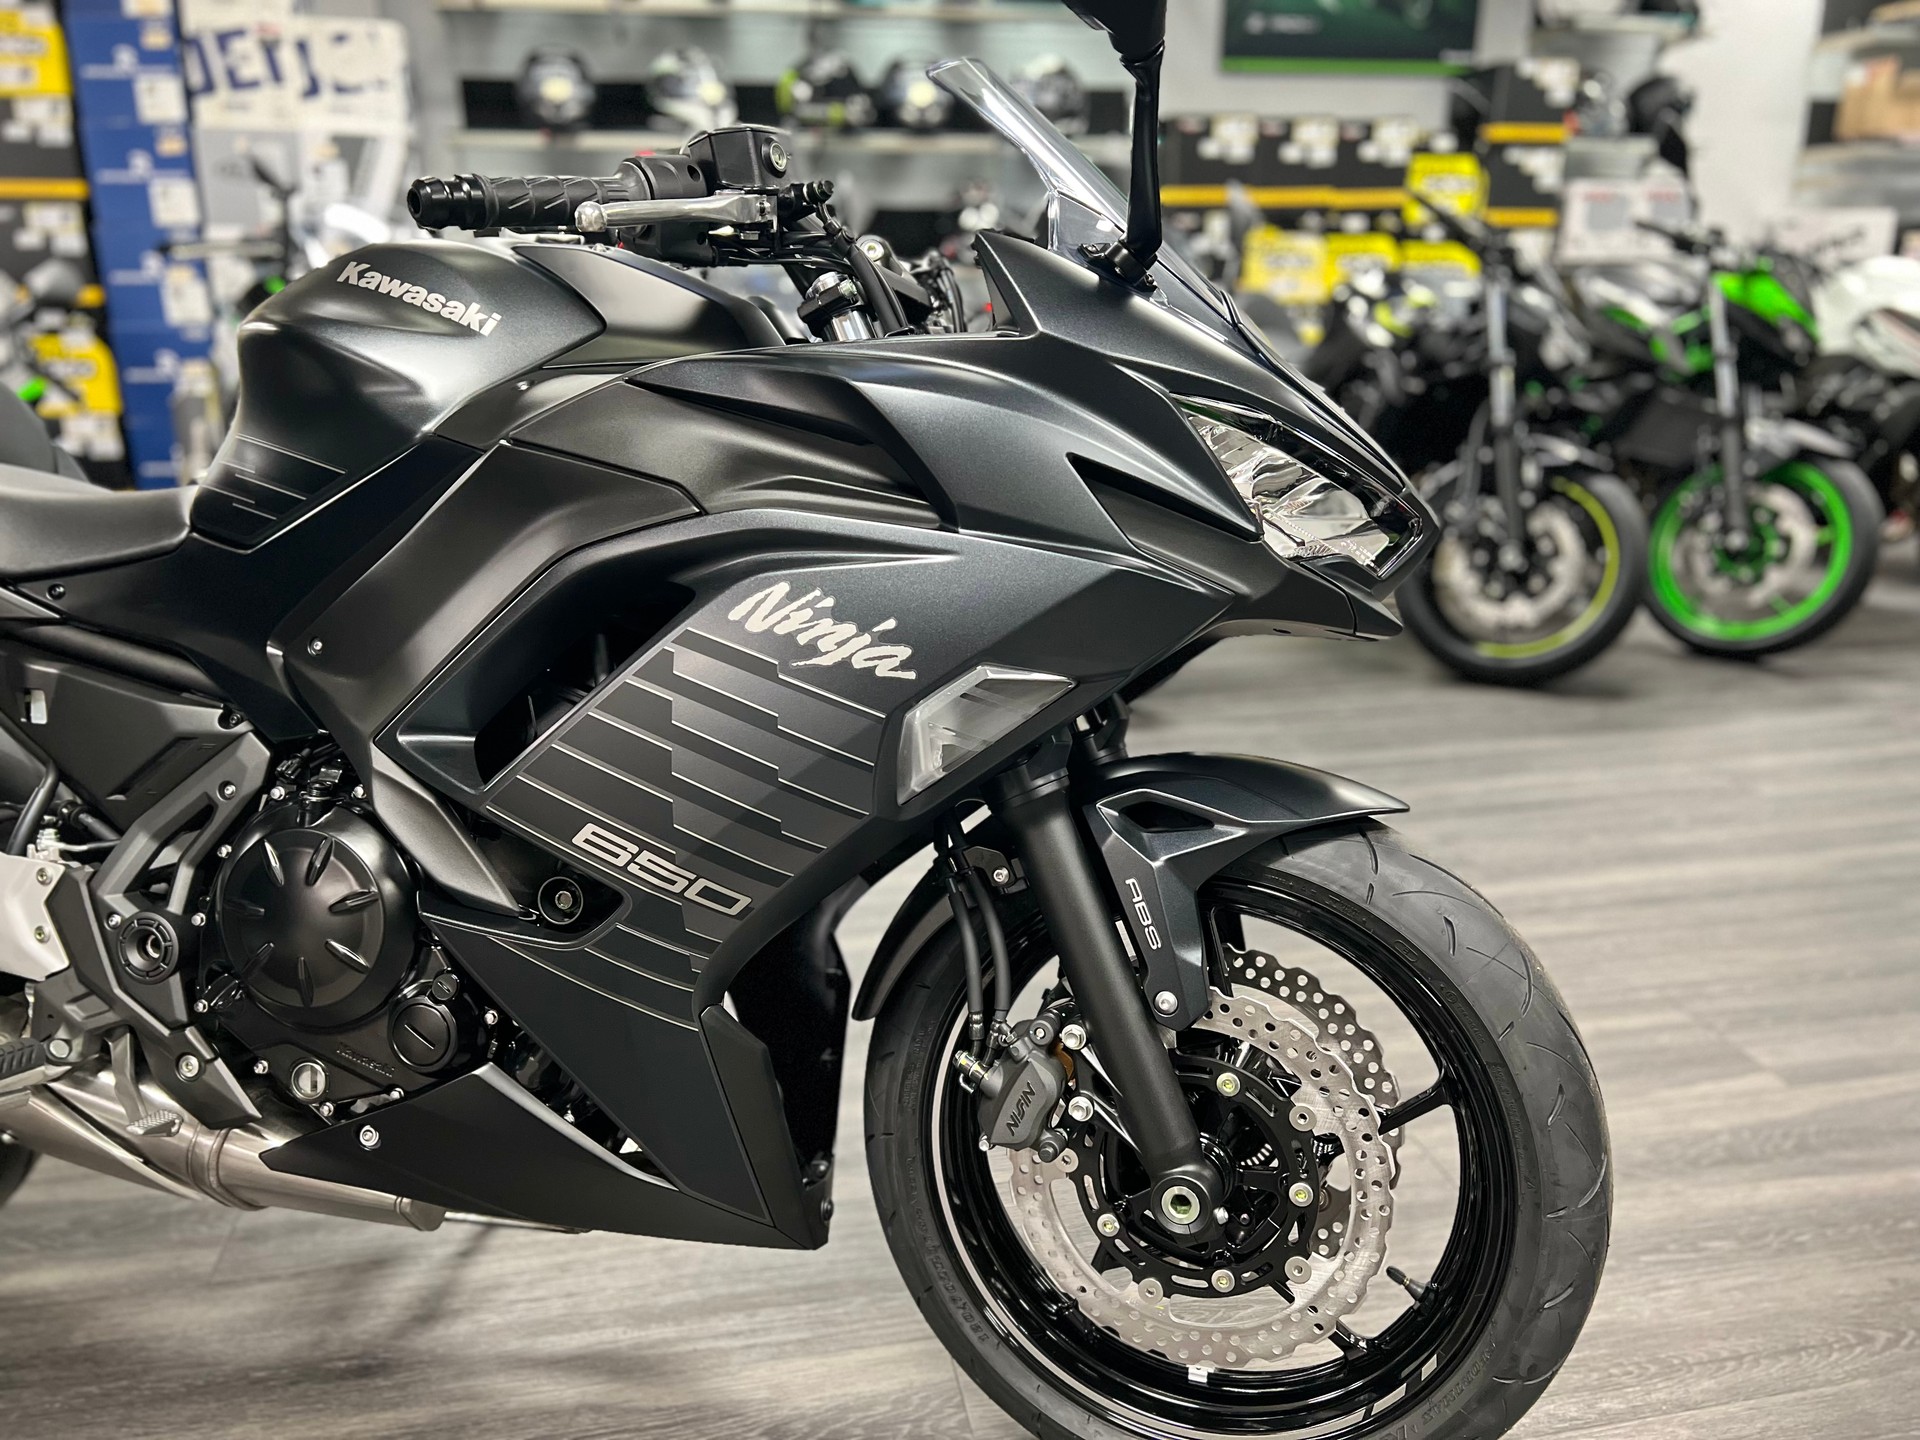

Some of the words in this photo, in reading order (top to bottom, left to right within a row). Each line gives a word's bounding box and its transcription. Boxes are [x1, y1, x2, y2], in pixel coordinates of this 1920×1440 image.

[337, 262, 502, 337] Kawasaki
[728, 582, 917, 680] Ninja
[572, 823, 752, 916] 650
[1125, 878, 1161, 950] ABS
[1006, 1080, 1036, 1137] NISSIN
